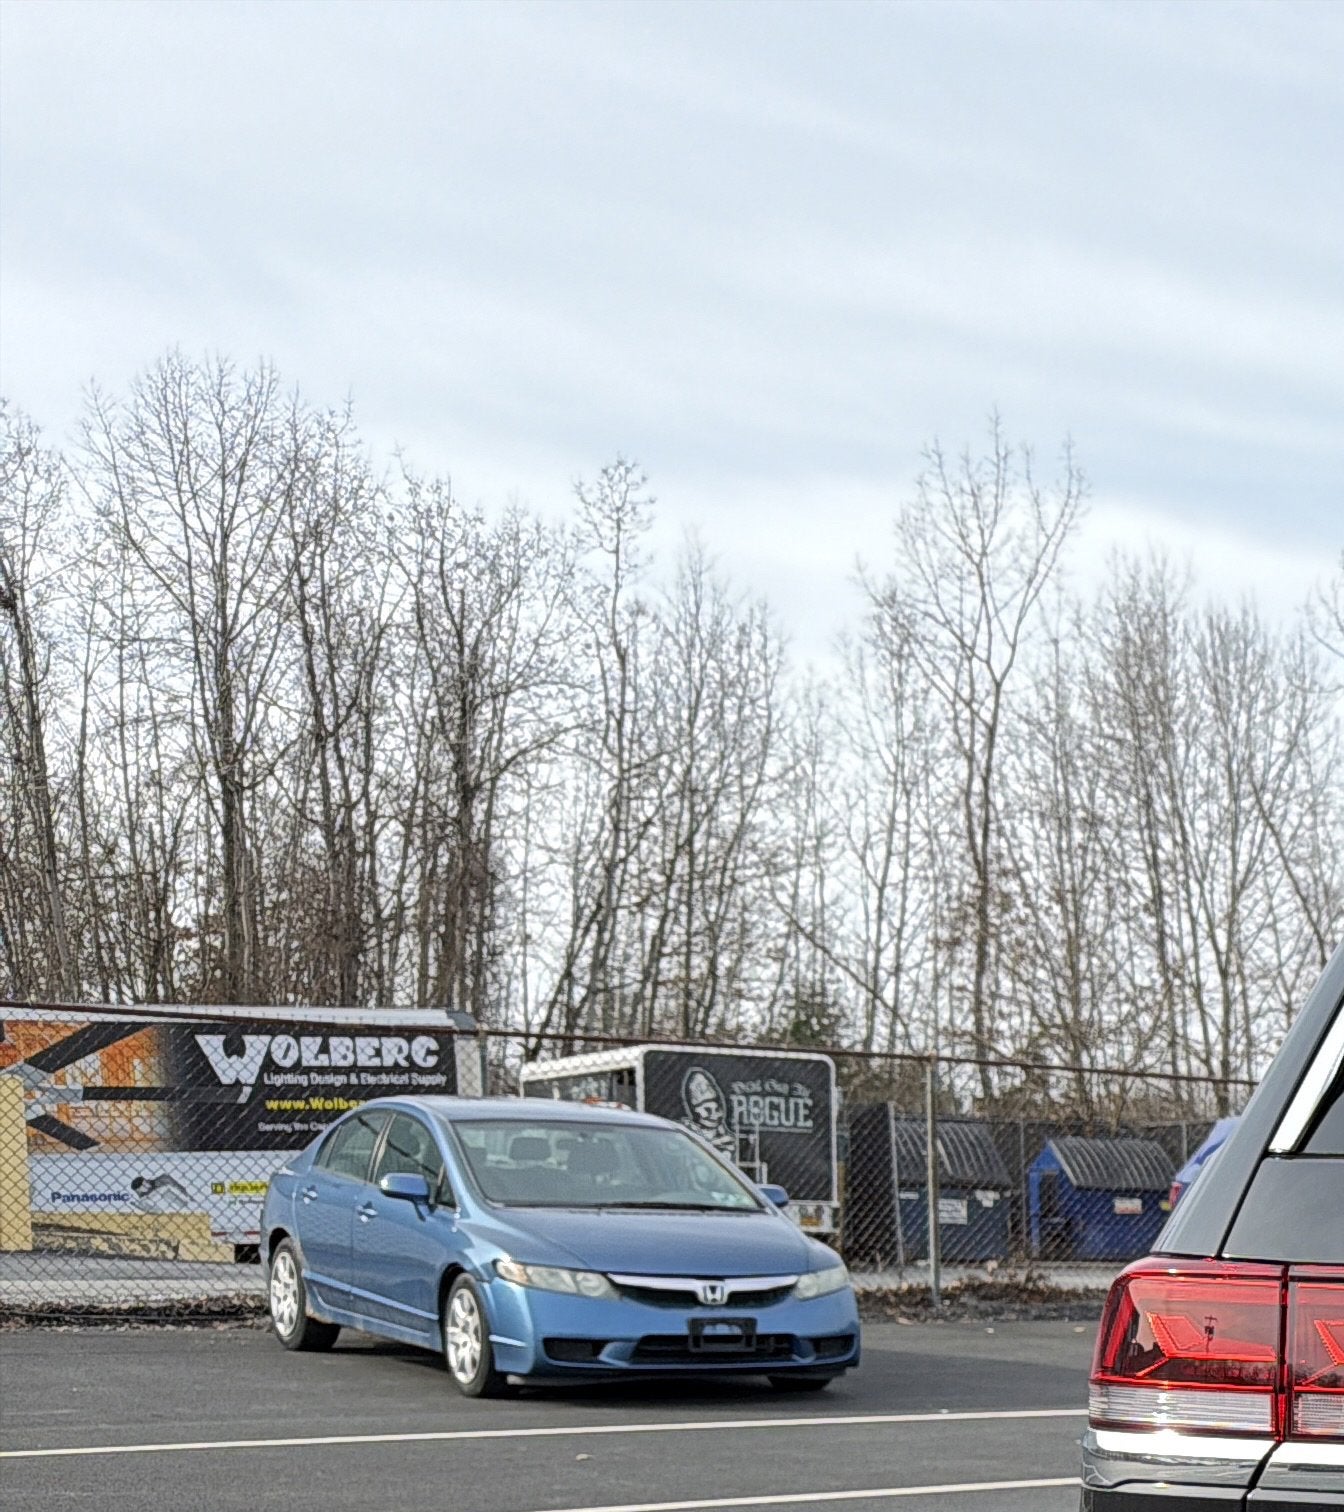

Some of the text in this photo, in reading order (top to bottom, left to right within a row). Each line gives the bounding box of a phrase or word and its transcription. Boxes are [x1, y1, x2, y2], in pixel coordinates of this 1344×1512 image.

[264, 1072, 308, 1087] Lighting
[310, 1072, 347, 1087] Design
[360, 1072, 409, 1086] Electrical
[411, 1072, 447, 1088] Supply
[730, 1093, 814, 1128] ROGUE
[51, 1191, 130, 1204] Panasonic
